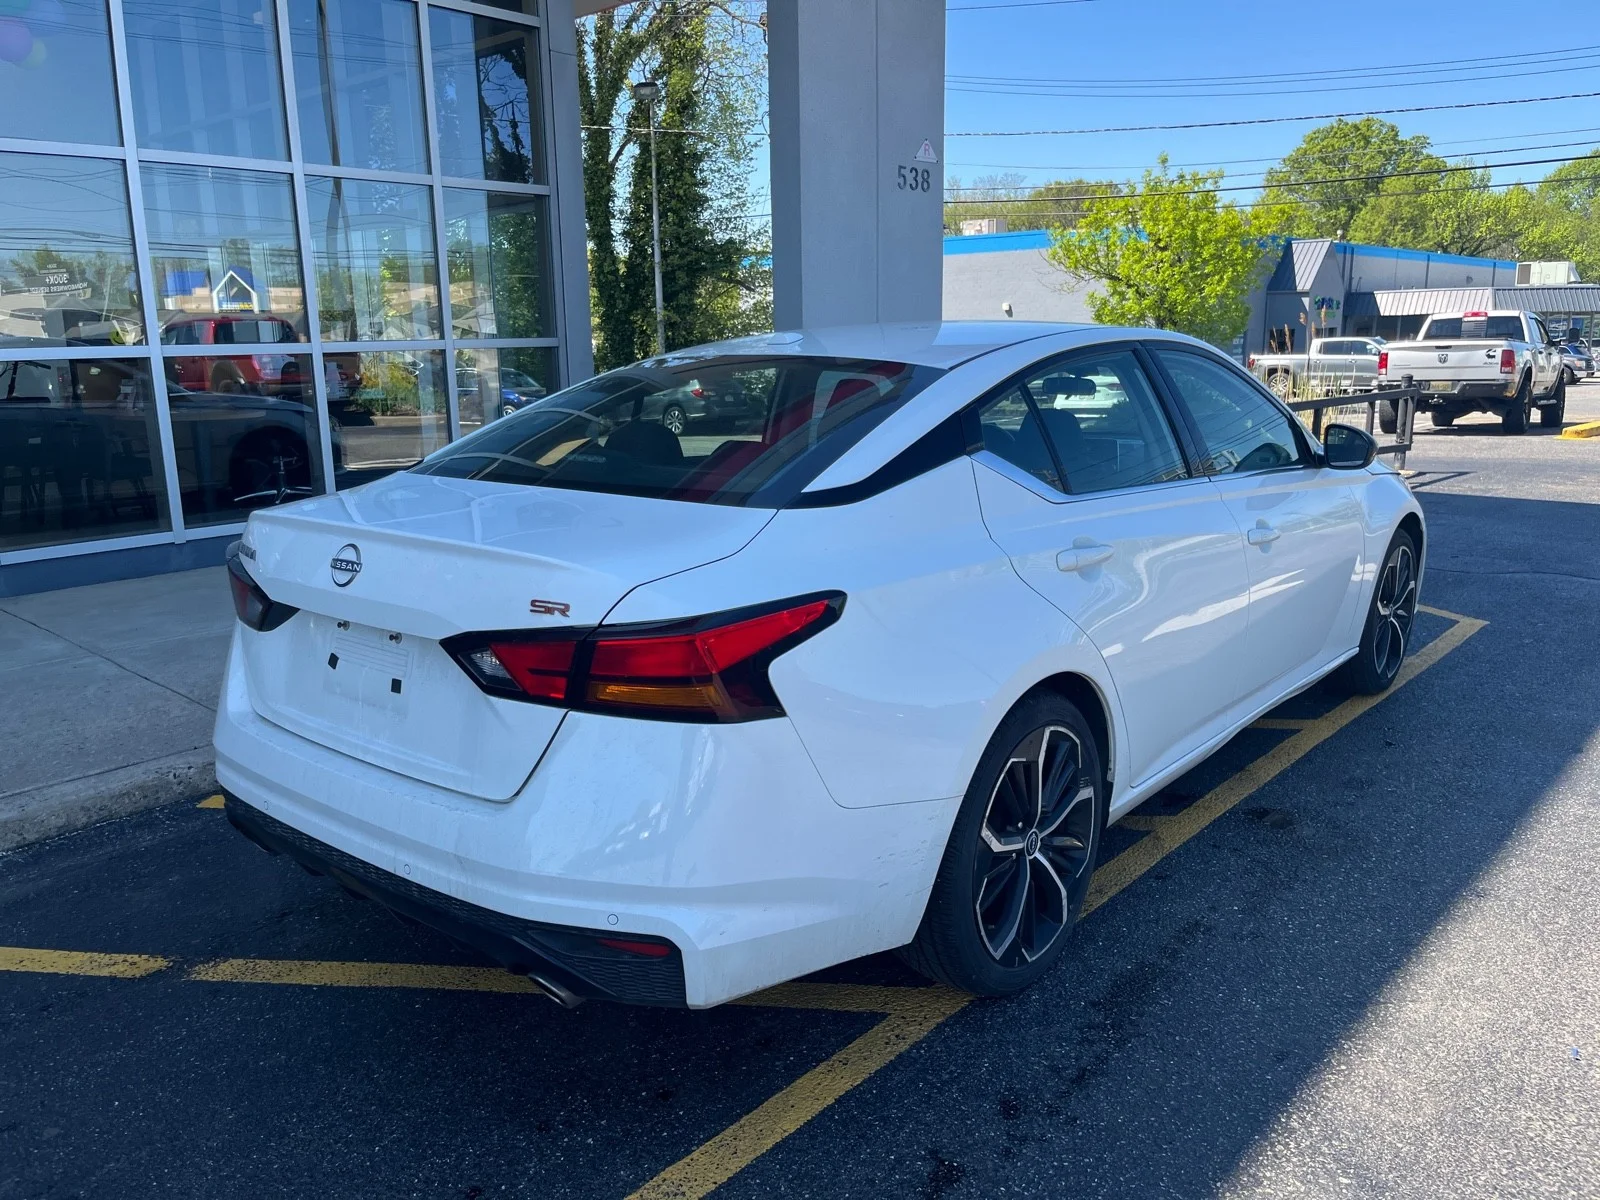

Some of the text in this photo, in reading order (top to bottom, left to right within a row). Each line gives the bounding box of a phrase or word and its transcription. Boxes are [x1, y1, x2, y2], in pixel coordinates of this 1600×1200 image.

[924, 144, 930, 156] R
[897, 165, 931, 192] 538
[529, 599, 571, 618] SR
